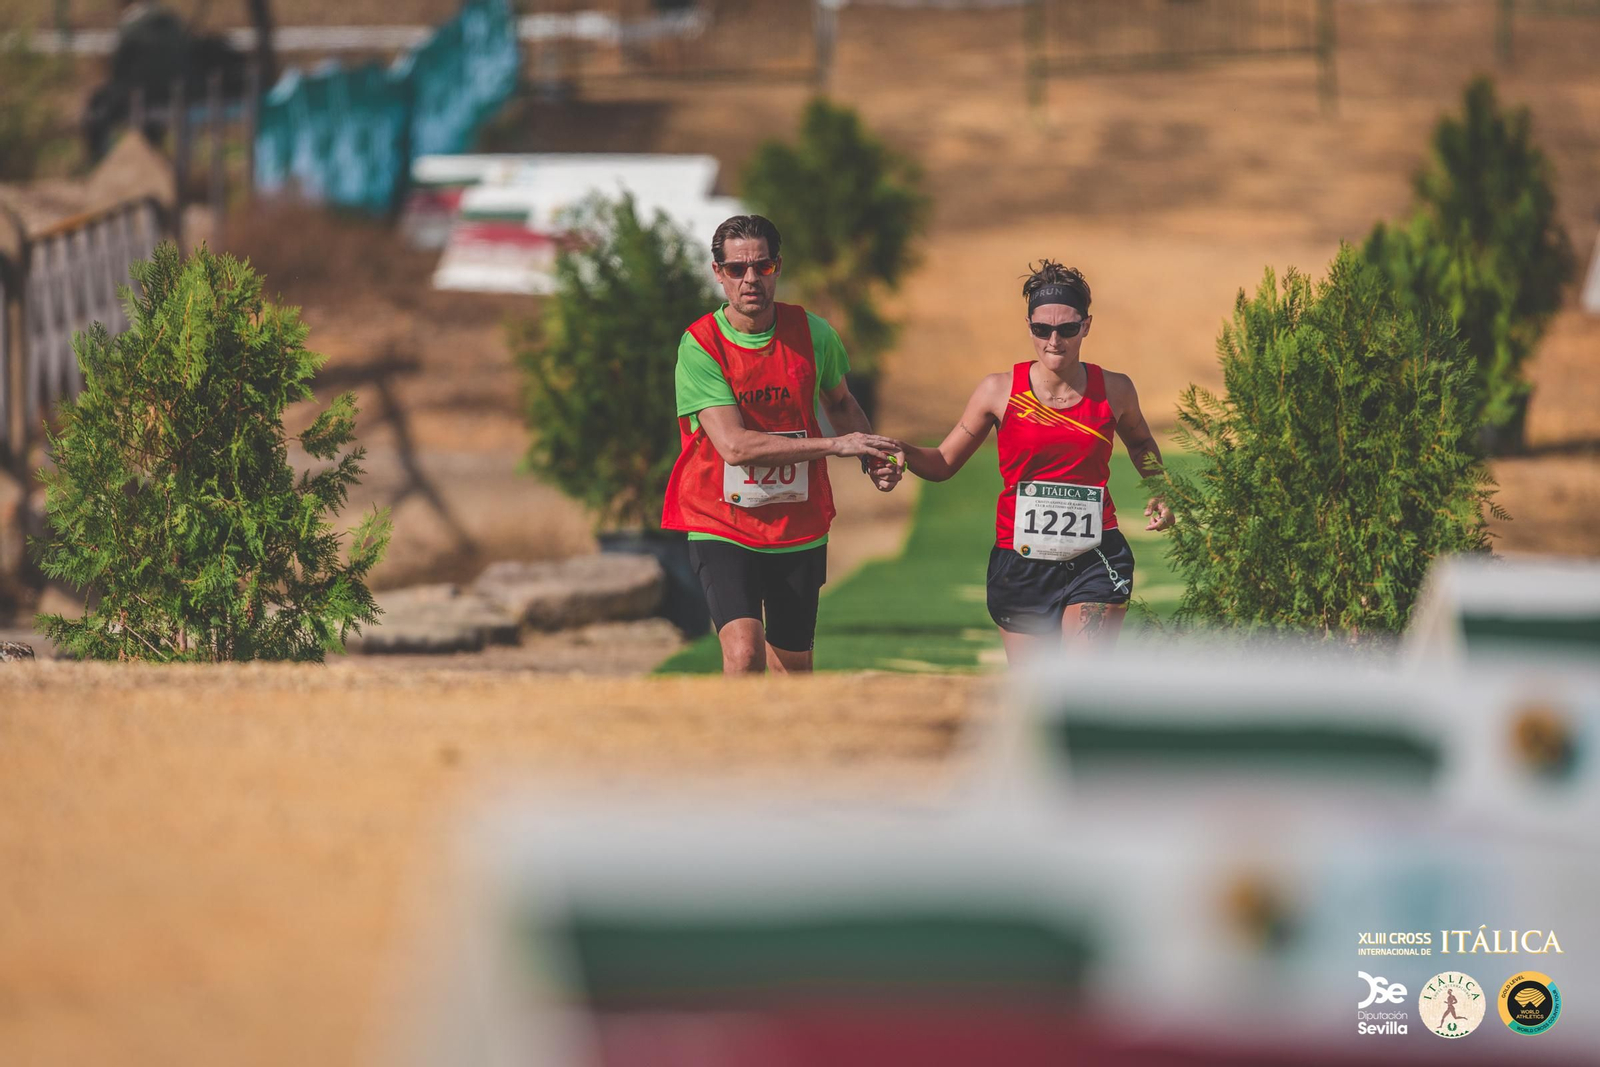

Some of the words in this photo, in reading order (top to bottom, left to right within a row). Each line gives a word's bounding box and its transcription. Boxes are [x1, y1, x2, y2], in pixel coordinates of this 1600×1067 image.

[737, 385, 791, 406] KIPSTA
[1042, 486, 1081, 498] ITÁLICA
[1024, 509, 1095, 538] 1221
